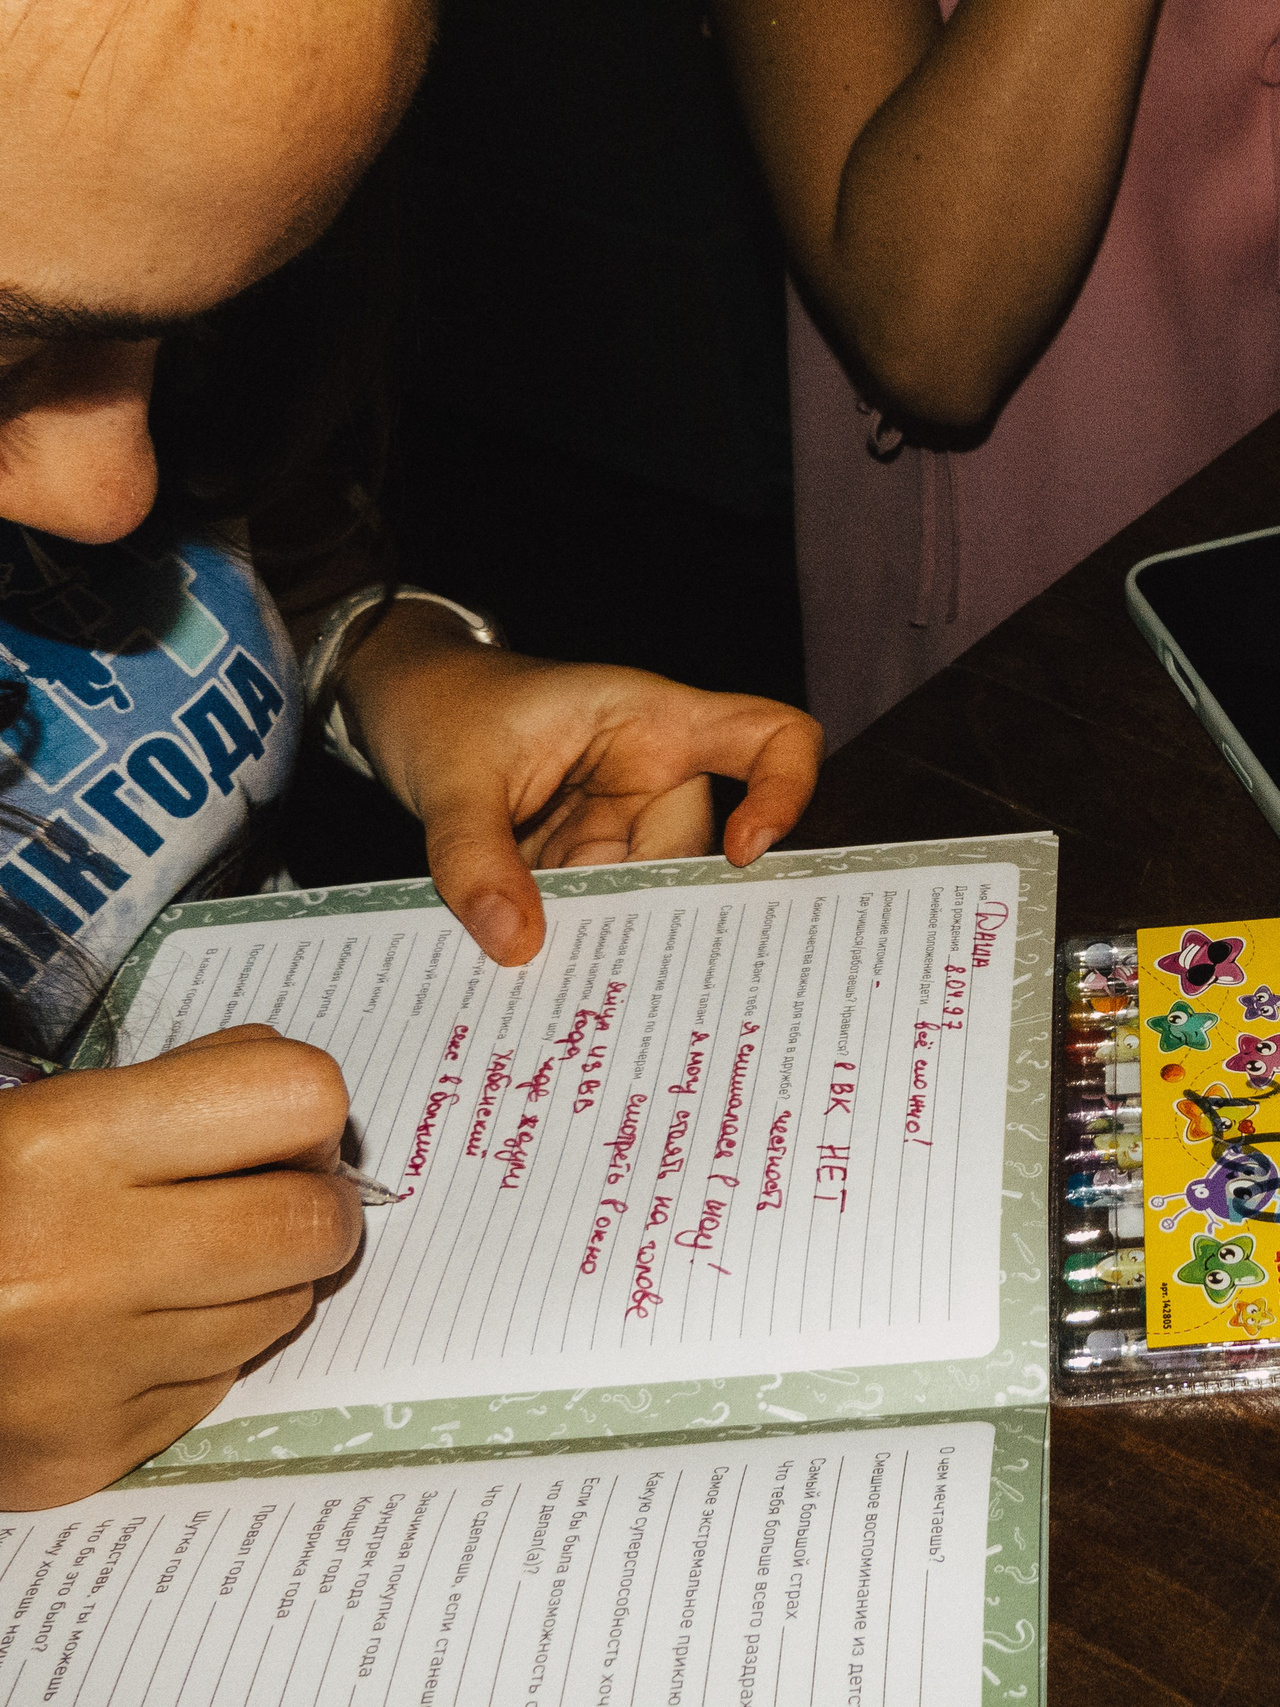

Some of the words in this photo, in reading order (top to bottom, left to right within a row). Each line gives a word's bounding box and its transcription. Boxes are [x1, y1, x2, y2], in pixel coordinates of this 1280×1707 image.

[80, 650, 284, 857] ГОДА
[810, 896, 827, 922] Какие
[859, 892, 873, 906] Где
[880, 891, 897, 934] Домашние
[928, 887, 945, 928] Семейное
[954, 885, 967, 906] Дата
[979, 884, 992, 900] Имя
[569, 919, 592, 961] Любимое
[593, 917, 615, 960] Любимый
[618, 914, 639, 956] Любимая
[665, 909, 686, 951] Любимое
[715, 905, 732, 934] Самый
[756, 901, 780, 958] Любопытный
[950, 908, 965, 952] рождения
[282, 941, 312, 988] Любимый
[330, 937, 358, 982] Любимая
[376, 933, 405, 984] Посоветуй
[424, 930, 452, 980] Посоветуй
[703, 936, 725, 990] необычный
[803, 924, 820, 964] качества
[845, 909, 870, 1002] учишься/работаешь?
[873, 937, 889, 976] питомцы
[190, 957, 210, 986] какой
[231, 944, 265, 998] Последний
[580, 962, 602, 1000] напиток
[612, 958, 626, 976] еда
[654, 954, 674, 990] занятие
[748, 961, 766, 983] факт
[796, 967, 811, 998] важны
[919, 931, 937, 1004] положение/дети
[176, 988, 198, 1018] город
[316, 984, 338, 1018] группа
[362, 986, 382, 1014] книгу
[410, 982, 432, 1017] сериал
[460, 978, 480, 1010] фильм
[496, 970, 528, 1040] актер/актриса
[551, 964, 581, 1020] тв/интернет
[647, 994, 663, 1018] дома
[694, 992, 709, 1025] талант
[744, 995, 759, 1017] тебе
[792, 1001, 806, 1019] для
[942, 965, 966, 1030] 8.04.97
[542, 1022, 558, 1042] шоу
[644, 1021, 656, 1033] по
[787, 1022, 803, 1044] тебя
[837, 1006, 855, 1056] Нравится?
[632, 1036, 653, 1080] вечерам
[668, 1052, 704, 1094] могу
[776, 1056, 795, 1100] дружбе?
[814, 1145, 850, 1213] НЕТ
[645, 1196, 673, 1230] на
[580, 1217, 612, 1274] окно
[1162, 1300, 1172, 1330] 142805
[936, 1458, 952, 1480] чем
[939, 1446, 955, 1454] О
[546, 1480, 564, 1501] что
[704, 1466, 729, 1506] Самое
[774, 1460, 794, 1482] Что
[803, 1458, 827, 1499] Самый
[866, 1452, 891, 1509] Смешное
[480, 1484, 504, 1507] Что
[576, 1477, 600, 1507] Если
[637, 1471, 665, 1513] Какую
[767, 1485, 788, 1516] тебя
[45, 1522, 82, 1556] Чему
[87, 1520, 114, 1542] Что
[174, 1510, 212, 1554] Шутка
[237, 1504, 278, 1556] Провал
[292, 1499, 342, 1576] Вечеринка
[335, 1496, 374, 1553] Концерт
[361, 1493, 406, 1568] Саундтрек
[397, 1490, 438, 1559] Значимая
[522, 1504, 556, 1574] делал(а)?
[568, 1511, 588, 1530] бы
[792, 1503, 822, 1568] большой
[928, 1484, 949, 1564] мечтаешь?
[73, 1548, 95, 1566] бы
[86, 1516, 148, 1598] Представь,
[451, 1511, 488, 1588] сделаешь,
[556, 1535, 582, 1574] была
[756, 1520, 782, 1576] больше
[58, 1572, 78, 1596] это
[155, 1558, 182, 1594] года
[220, 1560, 245, 1596] года
[319, 1558, 344, 1594] года
[680, 1509, 716, 1629] экстремальное
[853, 1513, 880, 1630] воспоминание
[14, 1561, 54, 1619] хочешь
[276, 1582, 302, 1619] года
[346, 1572, 372, 1609] года
[373, 1564, 406, 1632] покупка
[603, 1516, 648, 1668] суперспособность
[749, 1582, 768, 1628] всего
[784, 1572, 804, 1620] страх
[31, 1602, 66, 1652] было?
[76, 1602, 96, 1624] ты
[439, 1593, 462, 1632] если
[528, 1579, 566, 1694] возможность
[851, 1636, 866, 1656] из
[43, 1630, 82, 1702] можешь
[358, 1637, 382, 1678] года
[420, 1638, 448, 1707] станеш
[847, 1664, 864, 1707] детс
